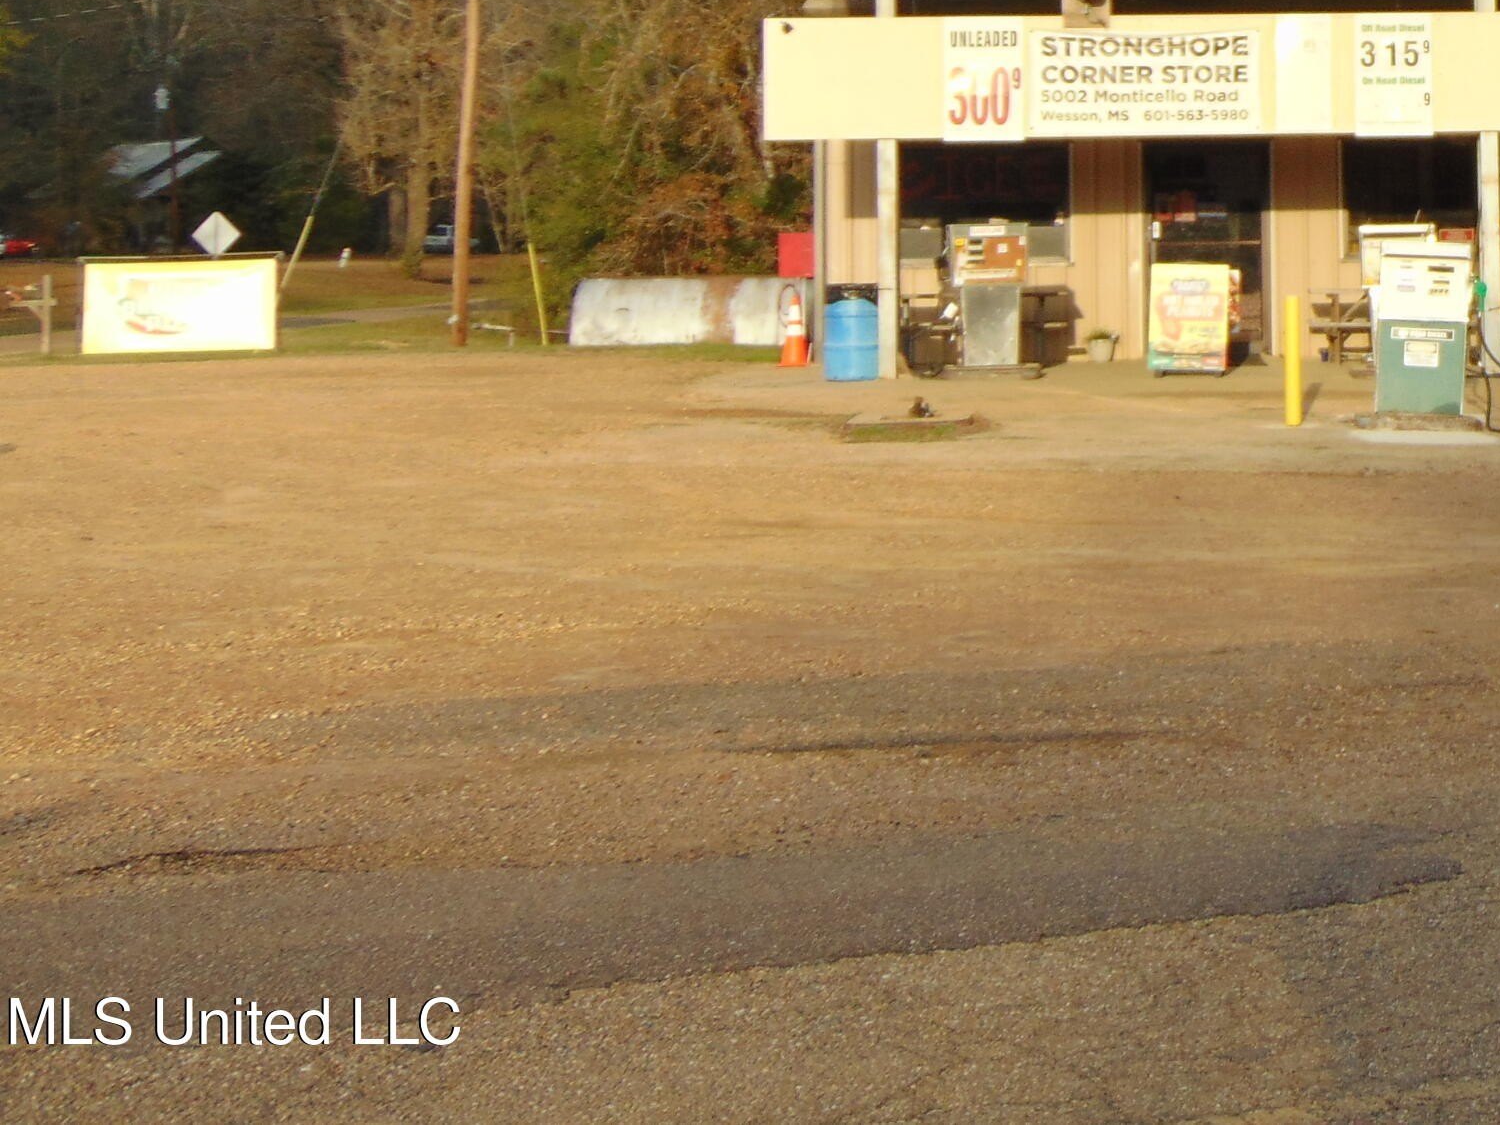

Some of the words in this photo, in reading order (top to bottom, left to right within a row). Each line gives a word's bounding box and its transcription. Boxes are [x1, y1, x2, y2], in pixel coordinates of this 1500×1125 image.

[1399, 24, 1425, 32] Diesel
[950, 30, 1017, 48] UNLEADED
[1040, 35, 1249, 58] STRONGHOPE
[1041, 65, 1152, 84] CORNER
[1162, 64, 1249, 83] STORE
[1400, 76, 1425, 85] Diesel
[1041, 90, 1088, 103] 5002
[1094, 89, 1187, 103] Monticello
[1194, 90, 1239, 102] Road
[1041, 111, 1101, 122] Wesson,
[1108, 110, 1129, 121] MS
[1144, 109, 1249, 121] 601-563-5980
